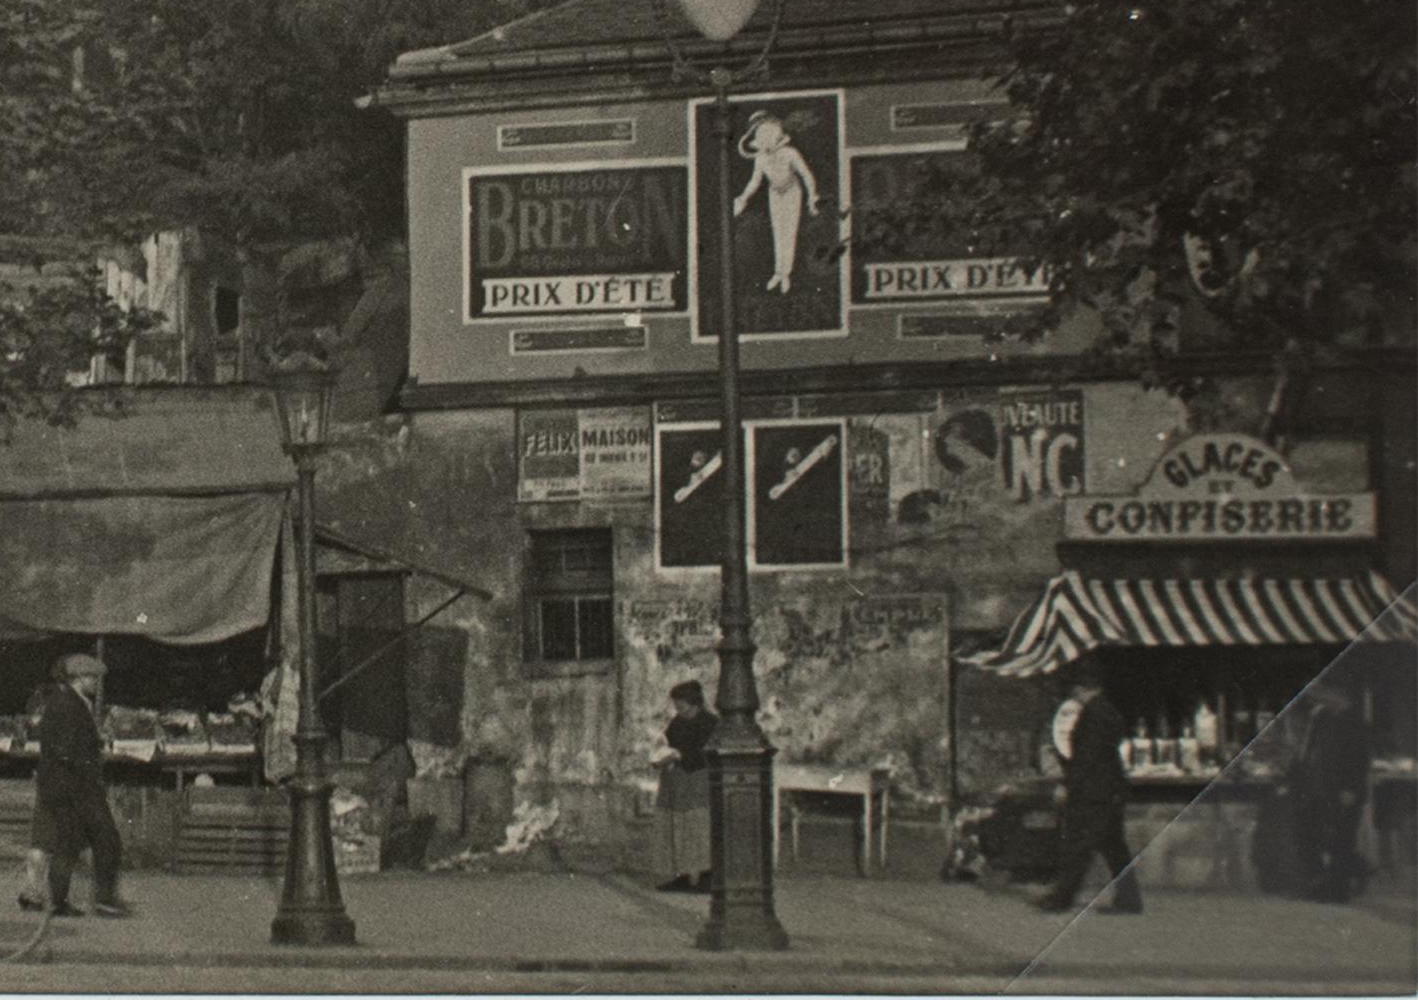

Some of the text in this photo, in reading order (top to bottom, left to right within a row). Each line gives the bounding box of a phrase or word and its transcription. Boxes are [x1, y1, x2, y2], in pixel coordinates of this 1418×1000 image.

[477, 169, 680, 269] BRETON
[491, 276, 665, 307] PRIX D'ÉTÉ
[874, 265, 951, 292] PRIX
[582, 428, 649, 449] MAISON
[1163, 442, 1280, 489] GLACES
[1207, 479, 1236, 495] ET
[1085, 498, 1353, 536] CONFISERIE
